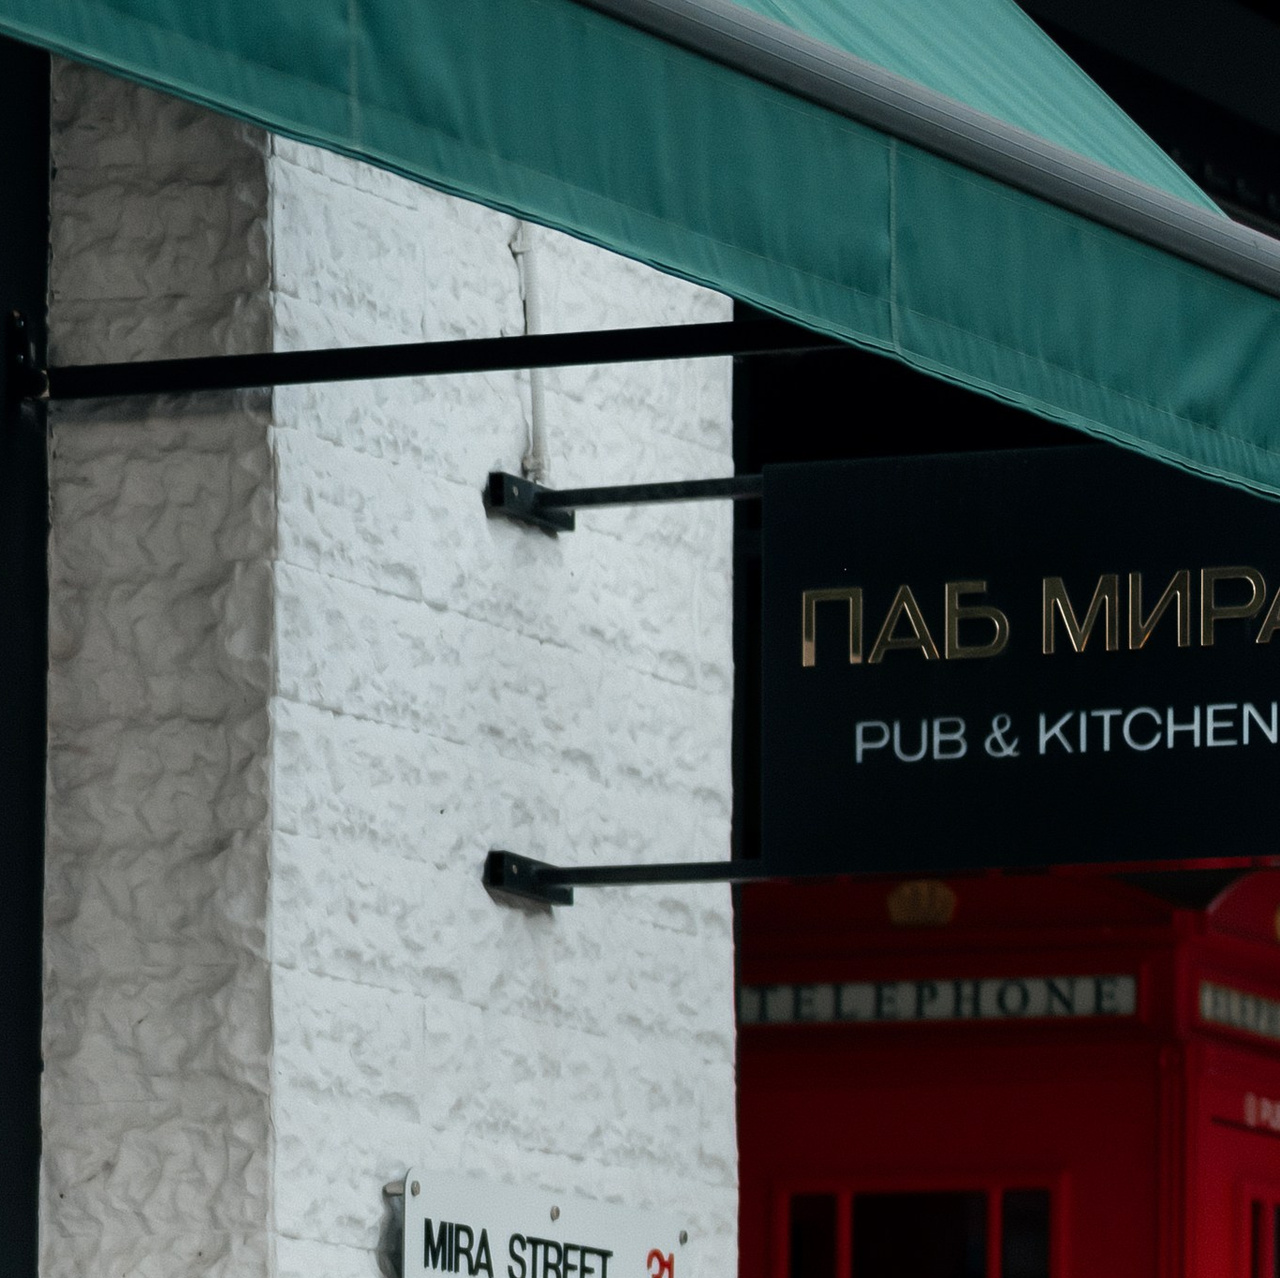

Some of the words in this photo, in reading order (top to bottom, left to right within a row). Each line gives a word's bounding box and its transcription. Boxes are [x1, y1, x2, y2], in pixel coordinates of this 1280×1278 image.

[802, 580, 1009, 667] ПАБ
[855, 717, 967, 763] PUB
[984, 713, 1020, 758] &
[1038, 701, 1279, 755] KITCHEN
[754, 976, 1121, 1023] TELEPHONE
[423, 1217, 495, 1278] MIRA
